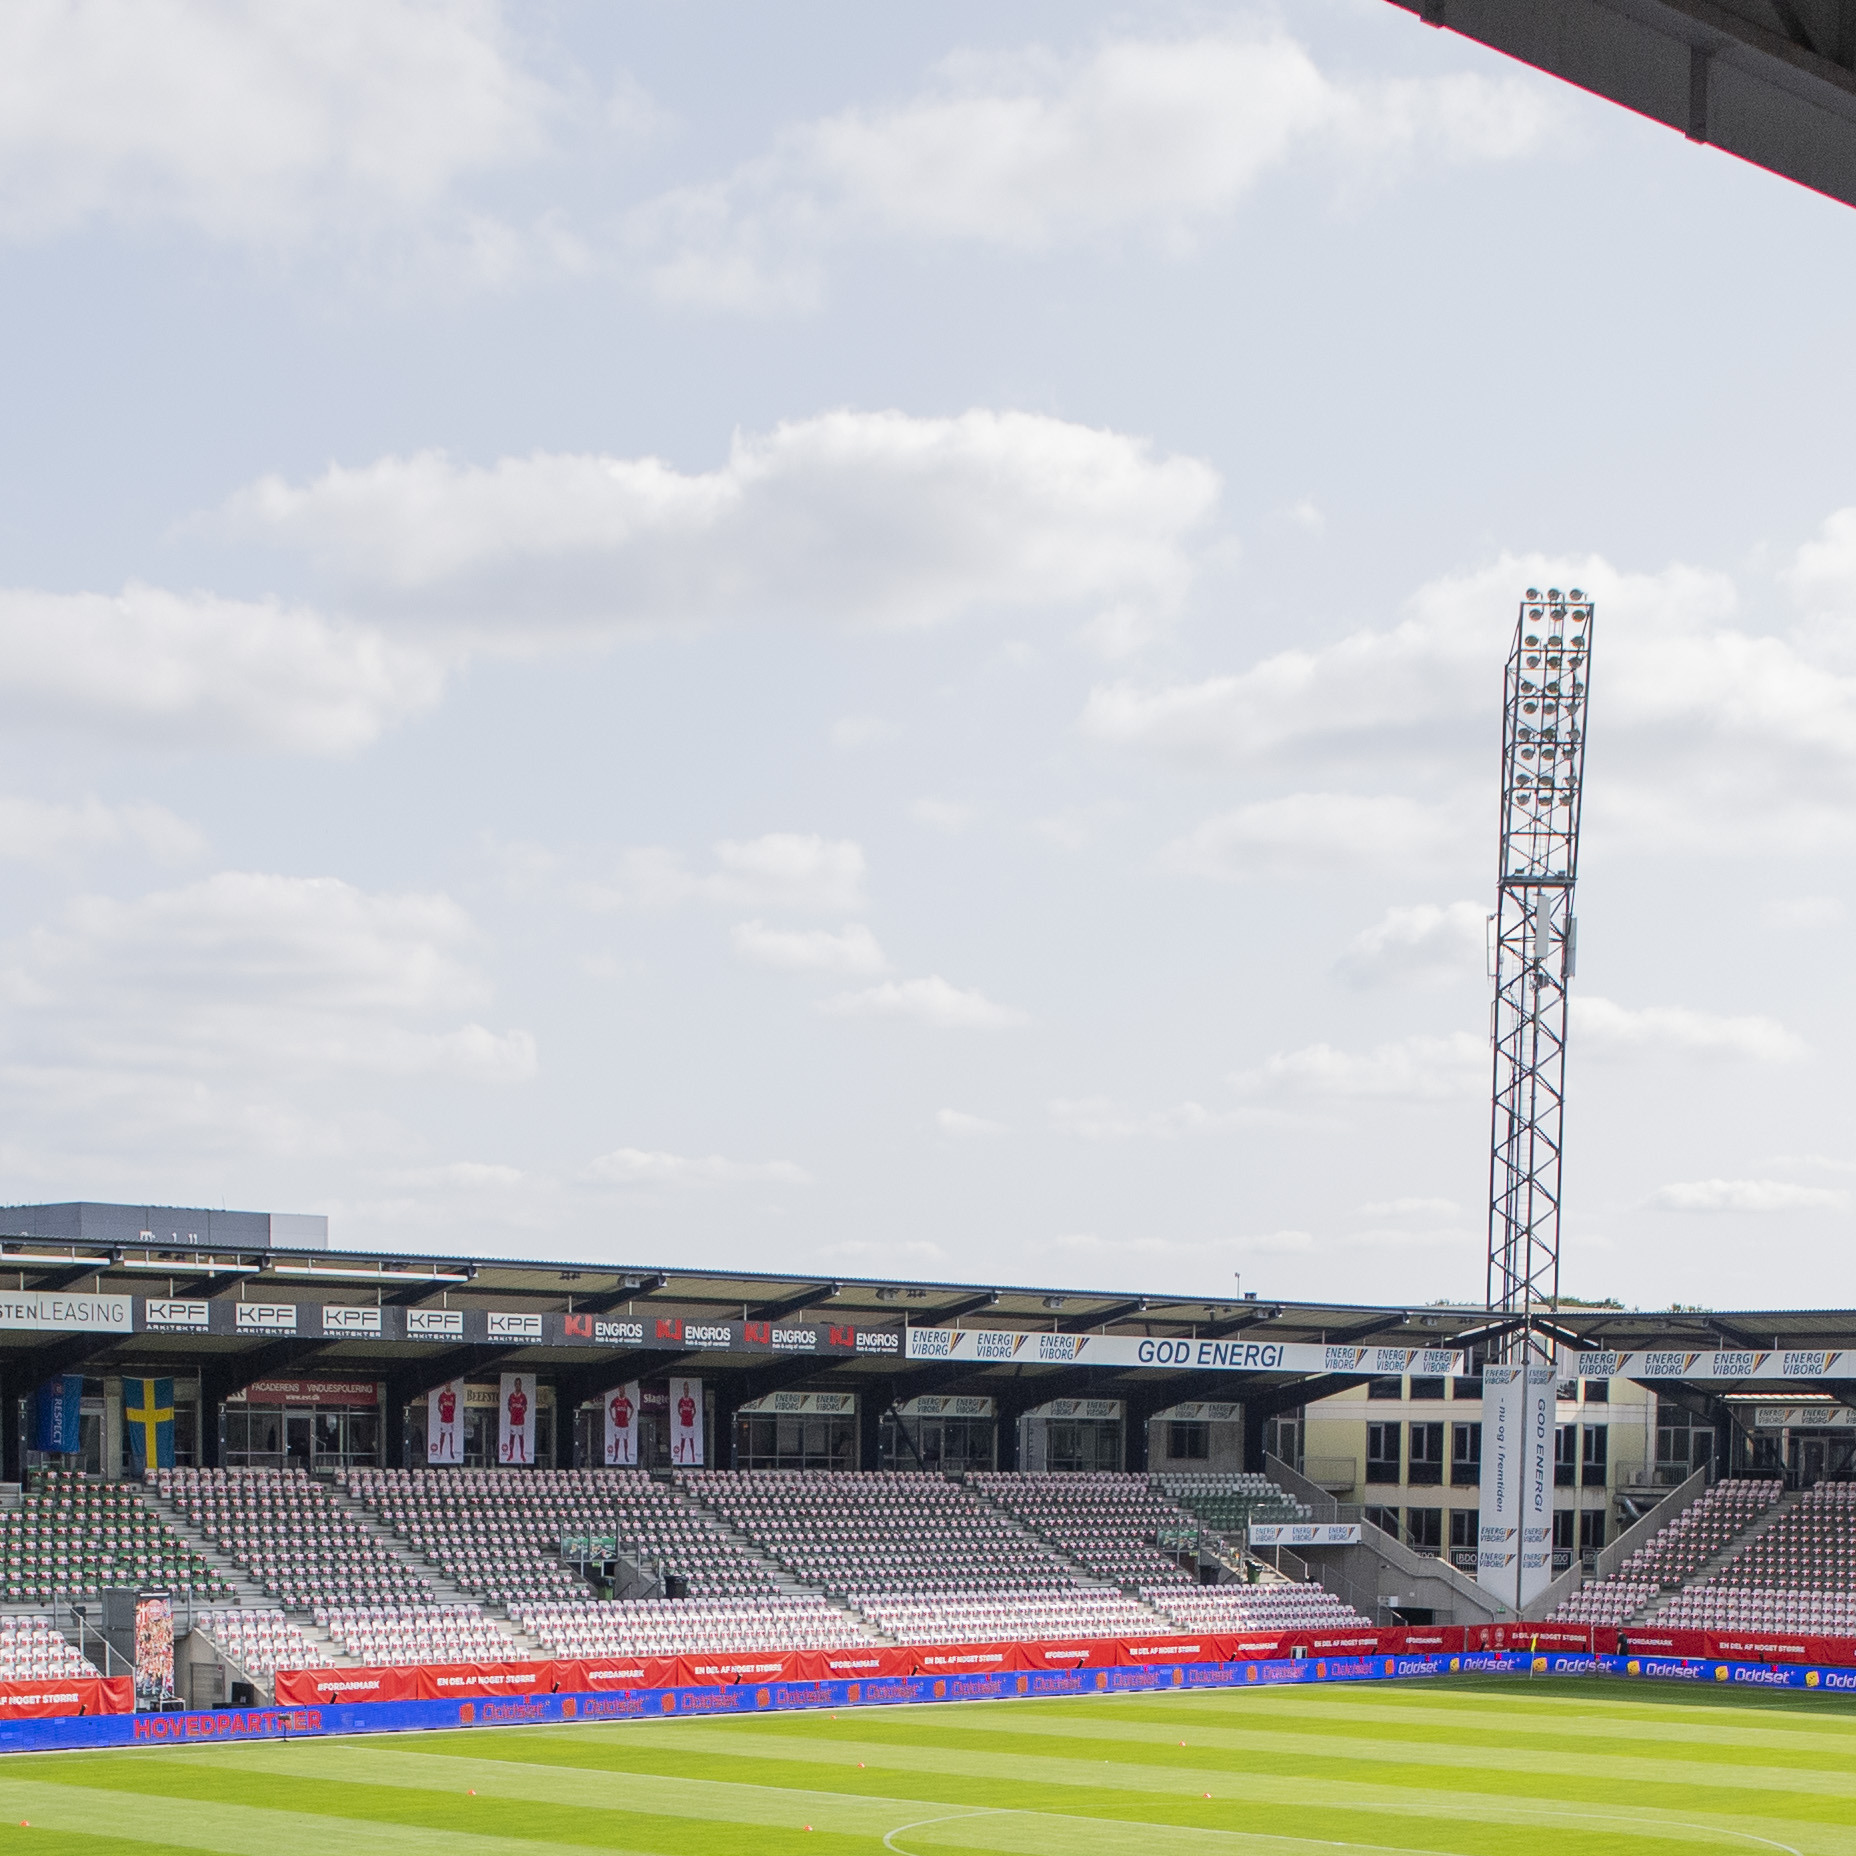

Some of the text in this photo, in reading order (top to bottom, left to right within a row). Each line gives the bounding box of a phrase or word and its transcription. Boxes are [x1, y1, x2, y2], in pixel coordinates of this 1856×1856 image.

[149, 1304, 206, 1320] KPF
[239, 1307, 293, 1322] KPF
[325, 1310, 379, 1326] KPF
[409, 1313, 461, 1329] KPF
[490, 1316, 540, 1332] KPF
[595, 1322, 643, 1338] ENGROS
[685, 1326, 731, 1341] ENGROS
[772, 1330, 816, 1345] ENGROS
[856, 1333, 899, 1348] ENGROS
[912, 1331, 950, 1344] ENERGI
[976, 1333, 1014, 1346] ENERGI
[1040, 1335, 1076, 1348] ENERGI
[911, 1343, 948, 1356] VIBORG
[975, 1345, 1012, 1358] VIBORG
[1039, 1347, 1074, 1360] VIBORG
[1138, 1340, 1285, 1367] GOD ENERGI
[1325, 1347, 1357, 1358] ENERGI
[1376, 1349, 1408, 1360] ENERGI
[1423, 1351, 1455, 1362] ENERGI
[1579, 1353, 1617, 1364] ENERGI
[1645, 1353, 1684, 1364] ENERGI
[1714, 1353, 1754, 1365] ENERGI
[1784, 1353, 1825, 1365] ENERGI
[1324, 1358, 1355, 1369] VIBORG
[1376, 1360, 1405, 1371] VIBORG
[1422, 1361, 1451, 1372] VIBORG
[1578, 1364, 1615, 1375] VIBORG
[1645, 1364, 1682, 1375] VIBORG
[1713, 1364, 1752, 1375] VIBORG
[1782, 1363, 1824, 1375] VIBORG
[53, 1398, 63, 1445] RESPECT
[1535, 1399, 1545, 1513] GOD ENERGI
[1464, 1656, 1514, 1672] Oddset
[1554, 1659, 1613, 1673] Oddset
[1646, 1663, 1699, 1678] Oddset
[1734, 1668, 1790, 1684] Oddset
[134, 1711, 322, 1739] HOVEDPARTNER
